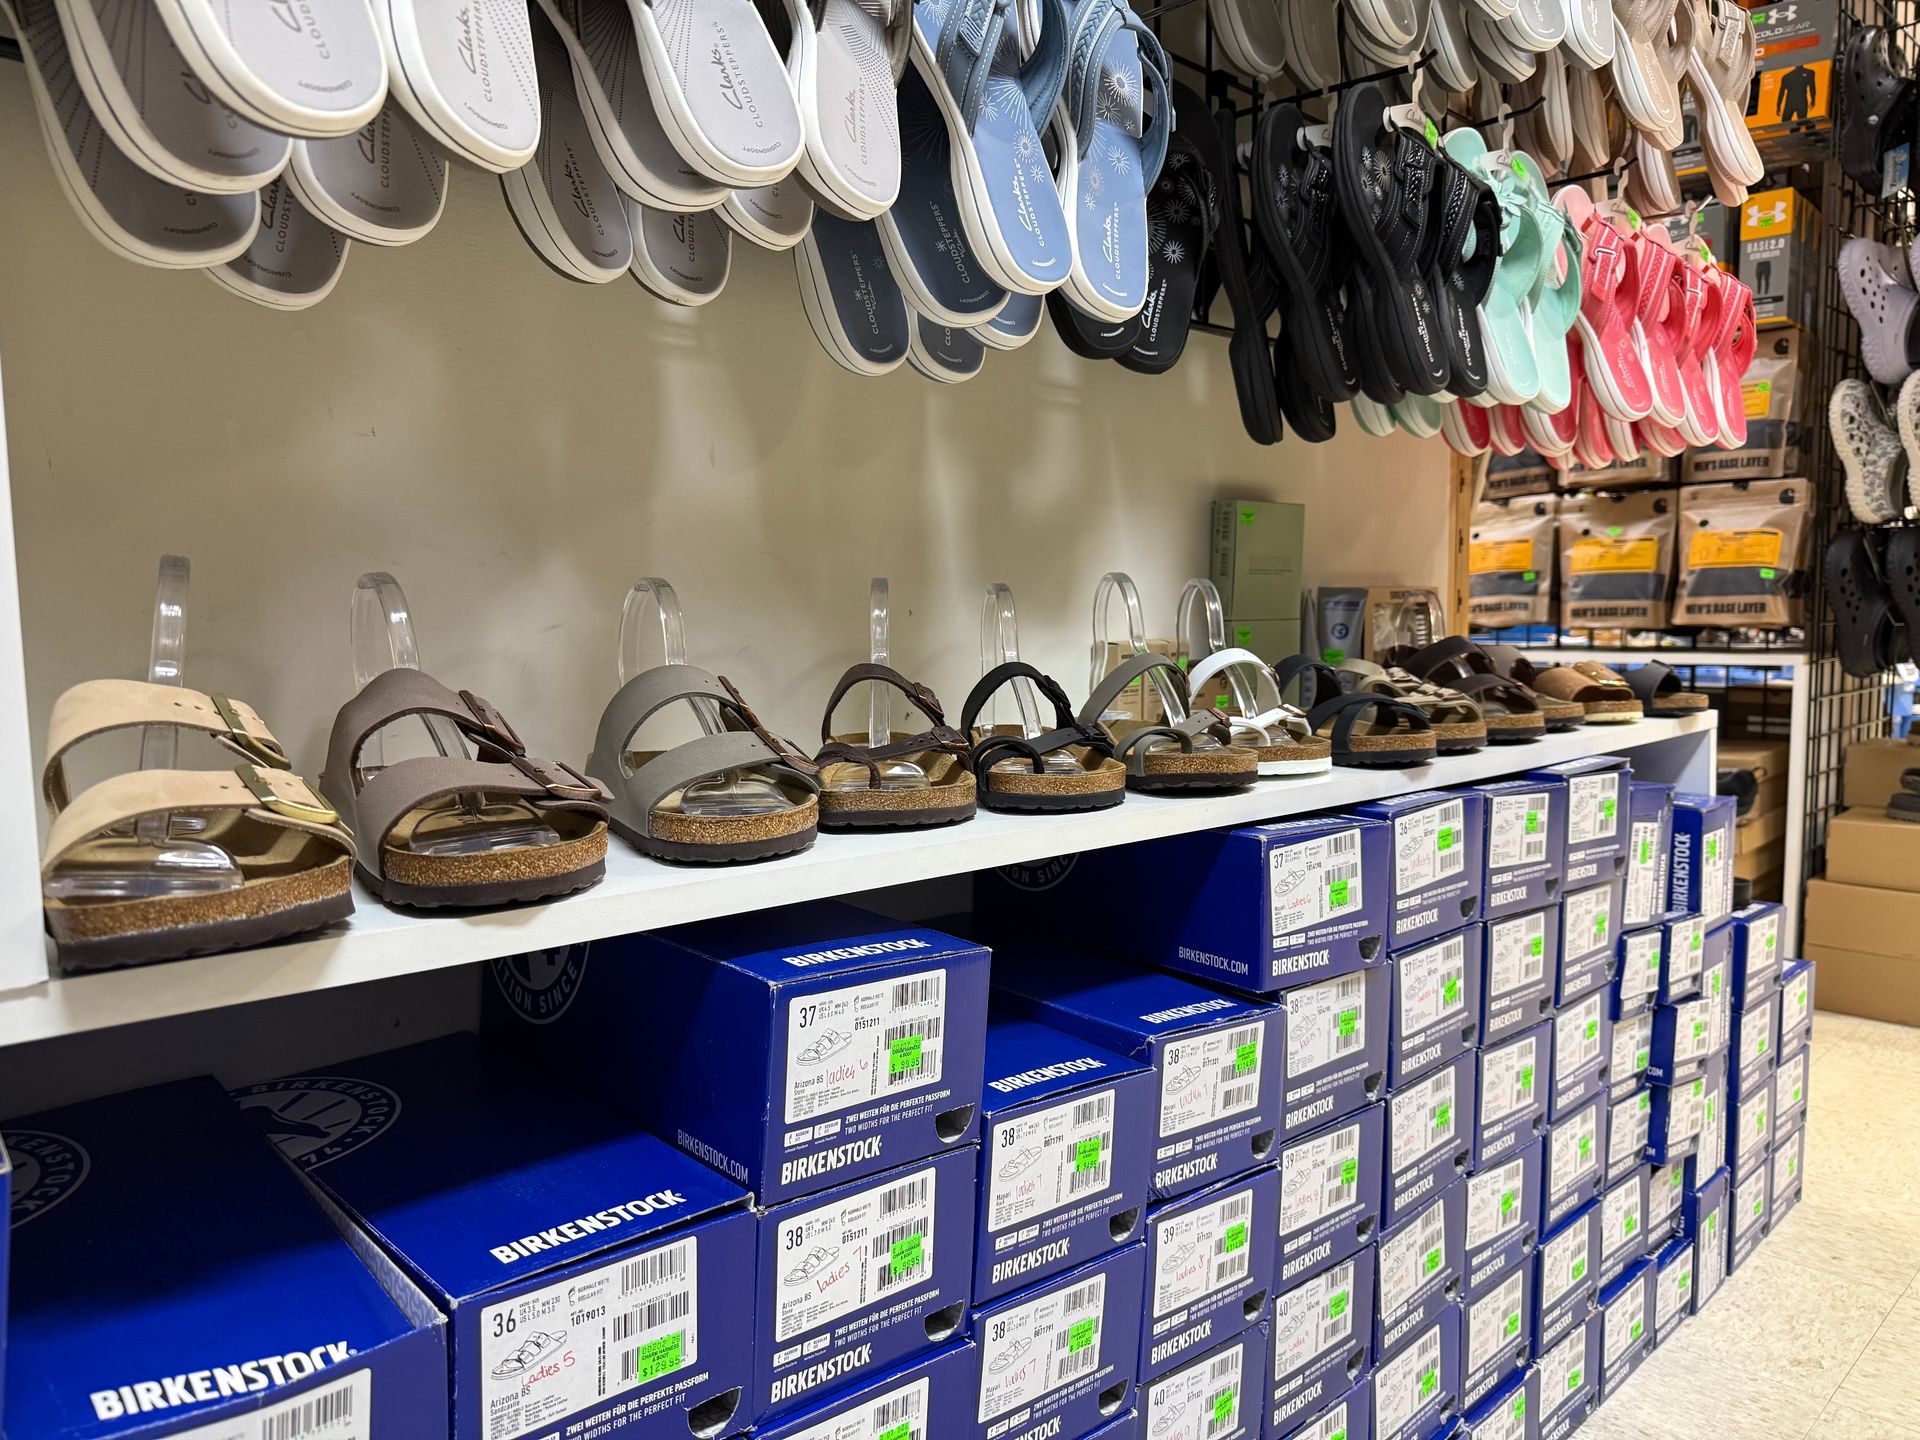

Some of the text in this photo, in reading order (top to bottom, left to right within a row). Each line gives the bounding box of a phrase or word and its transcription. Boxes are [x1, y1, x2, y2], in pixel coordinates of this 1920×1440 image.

[456, 7, 476, 75] Clarks
[711, 42, 743, 110] Clarks
[712, 21, 764, 128] CLOUDSTEPPERS
[844, 88, 857, 144] Clarks
[859, 76, 870, 166] CLOUDSTEPPERS
[742, 140, 782, 154] CUSHIONSOFT
[565, 160, 590, 218] Clarks
[566, 141, 605, 237] CLOUDSTEPPERS
[1012, 177, 1033, 232] Clarks
[1014, 159, 1045, 247] CLOUDSTEPPERS
[930, 201, 970, 284] CLOUDSTEPPERS
[1102, 214, 1113, 264] Clarks
[1114, 202, 1122, 280] CLOUDSTEPPERS
[850, 250, 879, 336] CLOUDSTEPPERS
[1141, 290, 1158, 329] Clarks
[1150, 279, 1168, 342] CLOUDSTEPPERS
[1740, 456, 1770, 468] LAYER
[1620, 606, 1649, 617] LAYER
[1713, 602, 1736, 614] BASE
[1737, 602, 1767, 614] LAYER
[1399, 821, 1408, 836] 36
[1273, 852, 1284, 869] 37
[1672, 832, 1691, 915] BIRKENSTOCK
[1491, 886, 1527, 907] BIRKENSTOCK
[1396, 908, 1439, 935] BIRKENSTOCK
[783, 938, 930, 967] BIRKENSTOCK
[1179, 946, 1249, 976] BIRKENSTOCK.COM
[1272, 949, 1329, 977] BIRKENSTOCK
[538, 960, 579, 1015] SINCE
[800, 1005, 817, 1029] 37
[854, 1016, 880, 1031] 0151211
[1139, 999, 1237, 1024] BIRKENSTOCK
[1290, 998, 1299, 1015] 38
[988, 1057, 1106, 1093] BIRKENSTOCK
[1168, 1048, 1180, 1066] 38
[1401, 1042, 1442, 1075] BIRKENSTOCK
[794, 1074, 824, 1090] Arizona BS
[250, 1077, 390, 1136] BIRKENSTOCK
[844, 1104, 934, 1136] TWO WIDTHS FOR THE PERFECT FIT
[845, 1088, 951, 1125] ZWEI WEITEN FÜR DIE PERFEKTE PASSFORM
[1285, 1095, 1334, 1130] BIRKENSTOCK
[1001, 1127, 1015, 1148] 38
[677, 1129, 749, 1184] BIRKENSTOCK.COM
[781, 1134, 881, 1187] BIRKENSTOCK
[1155, 1152, 1217, 1188] BIRKENSTOCK
[1285, 1152, 1295, 1170] 39
[1394, 1173, 1434, 1211] BIRKENSTOCK
[489, 1189, 684, 1264] BIRKENSTOCK
[1042, 1192, 1123, 1229] ZWEI WEITEN FÜR DIE PERFEKTE PASSFORM
[1042, 1206, 1110, 1238] TWO WIDTHS FOR THE PERFECT FIT
[786, 1226, 803, 1250] 38
[841, 1227, 868, 1245] 0151211
[1163, 1226, 1175, 1245] 39
[816, 1261, 851, 1293] ladies
[991, 1237, 1069, 1284] BIRKENSTOCK
[1282, 1240, 1331, 1281] BIRKENSTOCK
[577, 1291, 596, 1302] REGULAR
[782, 1292, 812, 1310] Arizona BS
[834, 1326, 848, 1338] ZWEI
[848, 1318, 868, 1333] WEITEN
[868, 1313, 879, 1325] FÜR
[879, 1310, 889, 1320] DIE
[889, 1300, 914, 1316] PERFEKTE
[914, 1288, 940, 1306] PASSFORM
[1279, 1301, 1289, 1317] 40
[492, 1308, 516, 1338] 36
[570, 1305, 606, 1327] 1019013
[834, 1306, 923, 1349] TWO WIDTHS FOR THE PERFECT FIT
[992, 1320, 1006, 1342] 38
[1384, 1305, 1424, 1349] BIRKENSTOCK
[1151, 1319, 1211, 1365] BIRKENSTOCK
[90, 1340, 352, 1421] BIRKENSTOCK
[521, 1362, 561, 1388] Ladies
[771, 1343, 870, 1404] BIRKENSTOCK
[1033, 1363, 1115, 1412] ZWEI WEITEN FÜR DIE PERFEKTE PASSFORM
[490, 1385, 531, 1410] Arizona BS
[566, 1421, 584, 1436] ZWEI
[584, 1409, 612, 1428] WEITEN
[612, 1402, 627, 1419] FÜR
[627, 1398, 640, 1411] DIE
[640, 1383, 674, 1407] PERFEKTE
[674, 1371, 709, 1393] PASSFORM
[1033, 1410, 1043, 1421] TWO
[1042, 1403, 1059, 1417] WIDTHS
[1059, 1397, 1068, 1408] FOR
[1068, 1394, 1076, 1404] THE
[1076, 1385, 1094, 1400] PERFECT
[1154, 1388, 1165, 1407] 40
[1273, 1380, 1322, 1426] BIRKENSTOCK
[584, 1421, 612, 1440] WIDTHS
[613, 1415, 628, 1430] FOR
[629, 1410, 642, 1424] THE
[644, 1396, 673, 1417] PERFECT
[675, 1392, 687, 1405] FIT
